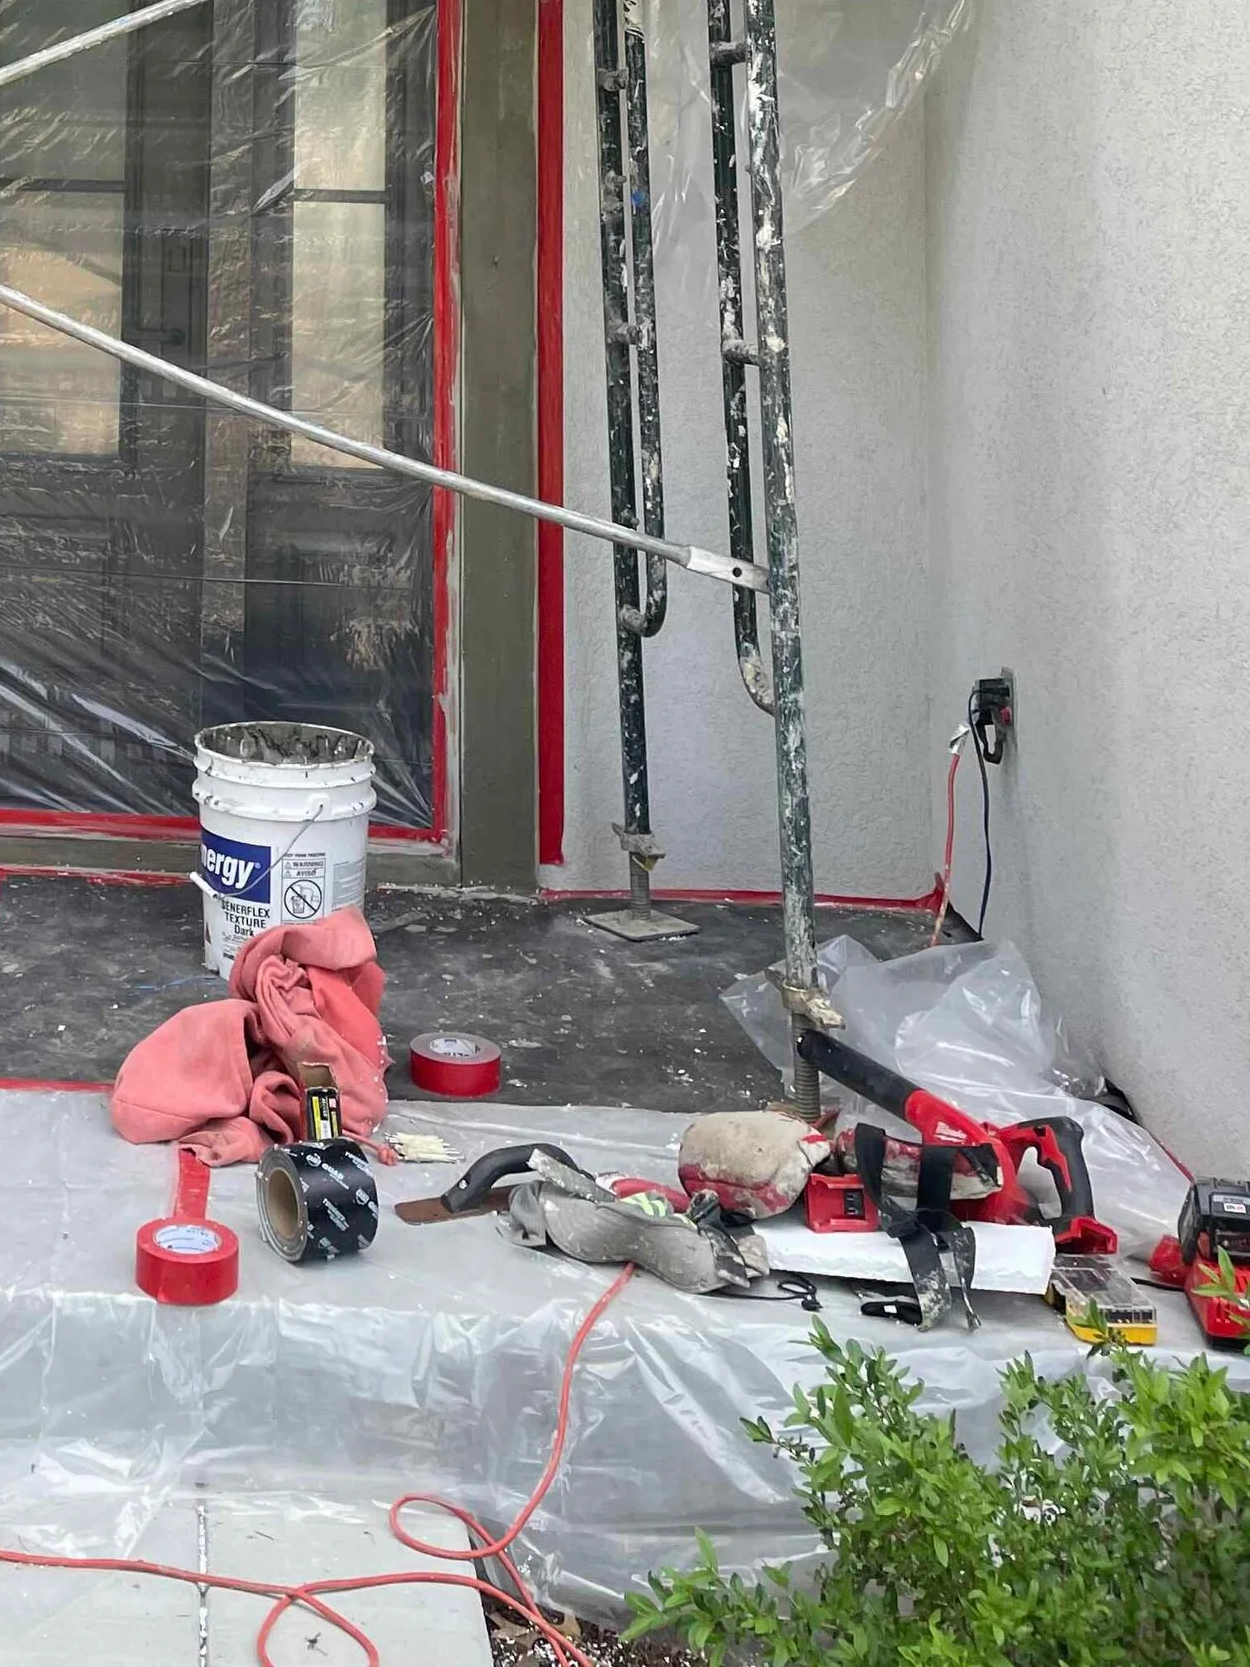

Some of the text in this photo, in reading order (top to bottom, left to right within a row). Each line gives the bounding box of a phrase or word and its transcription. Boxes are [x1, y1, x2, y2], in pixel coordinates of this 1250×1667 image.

[220, 899, 271, 919] SENERFLEX
[224, 911, 267, 929] TEXTURE
[234, 924, 255, 938] Dark
